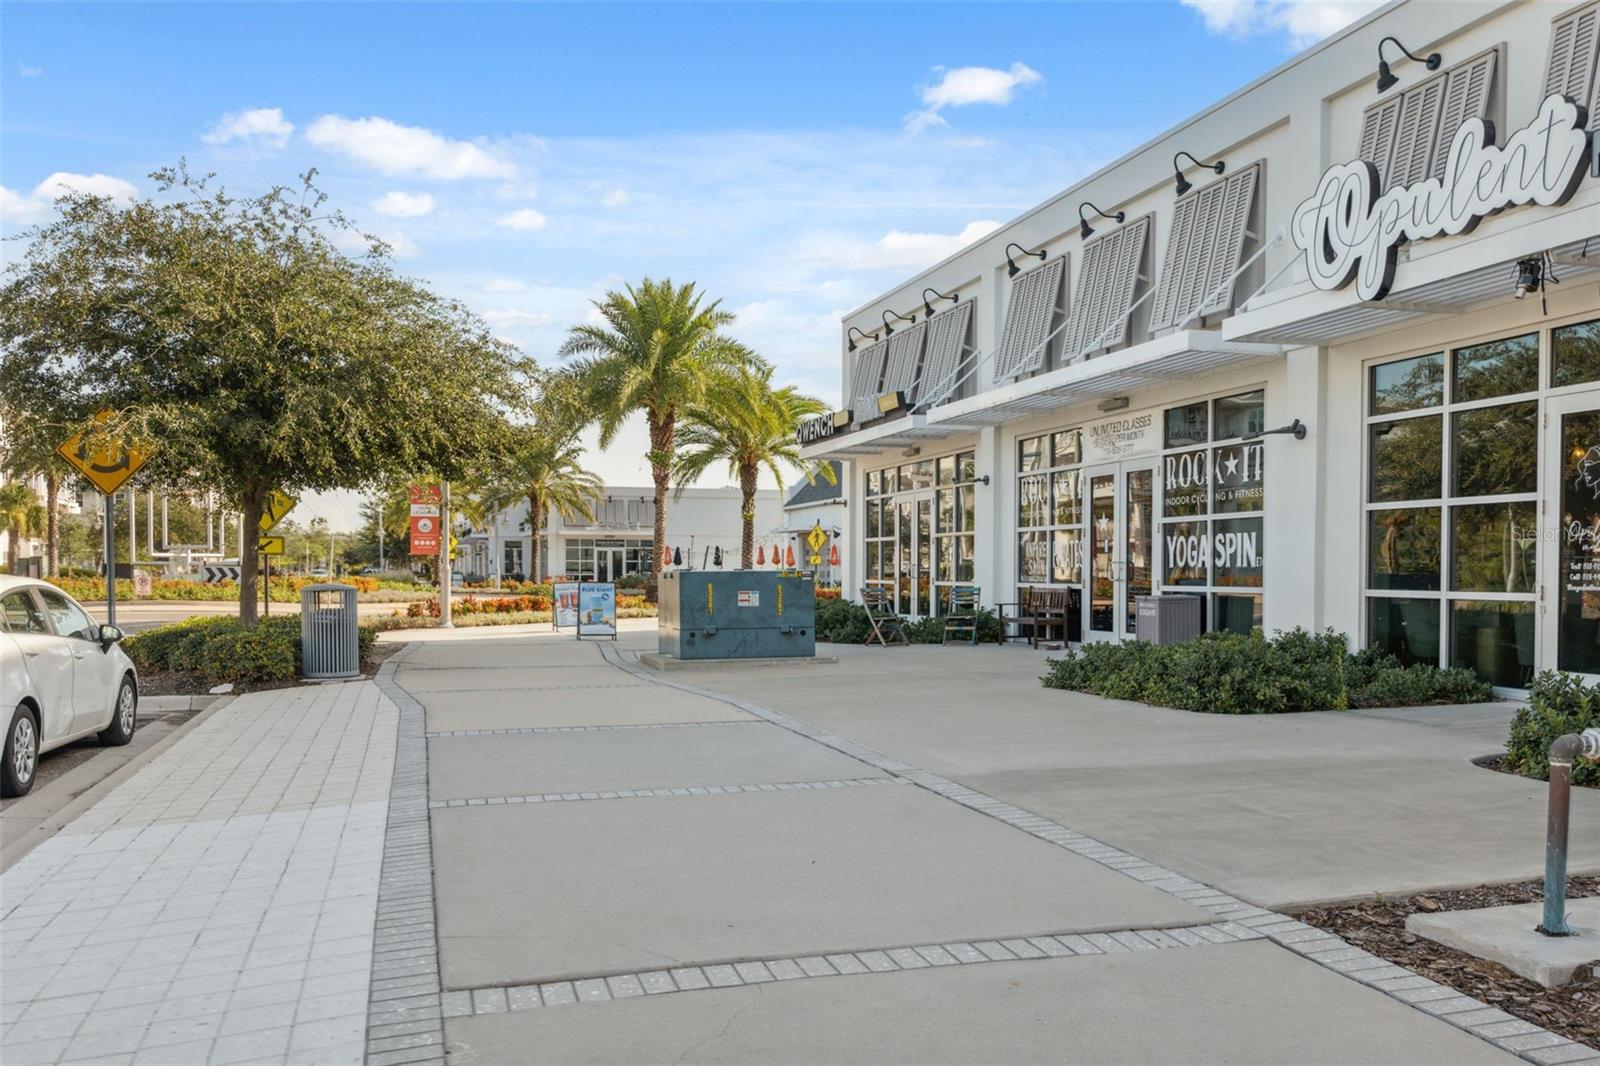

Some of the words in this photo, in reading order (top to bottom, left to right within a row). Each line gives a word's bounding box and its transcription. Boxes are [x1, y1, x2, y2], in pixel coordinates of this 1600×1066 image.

[1292, 95, 1586, 300] Opulent
[1123, 414, 1152, 431] CLASSES
[1191, 491, 1226, 503] CYCLNG
[1235, 487, 1263, 499] FITNESS
[1167, 535, 1208, 568] YOGA
[1215, 532, 1256, 568] SPIN
